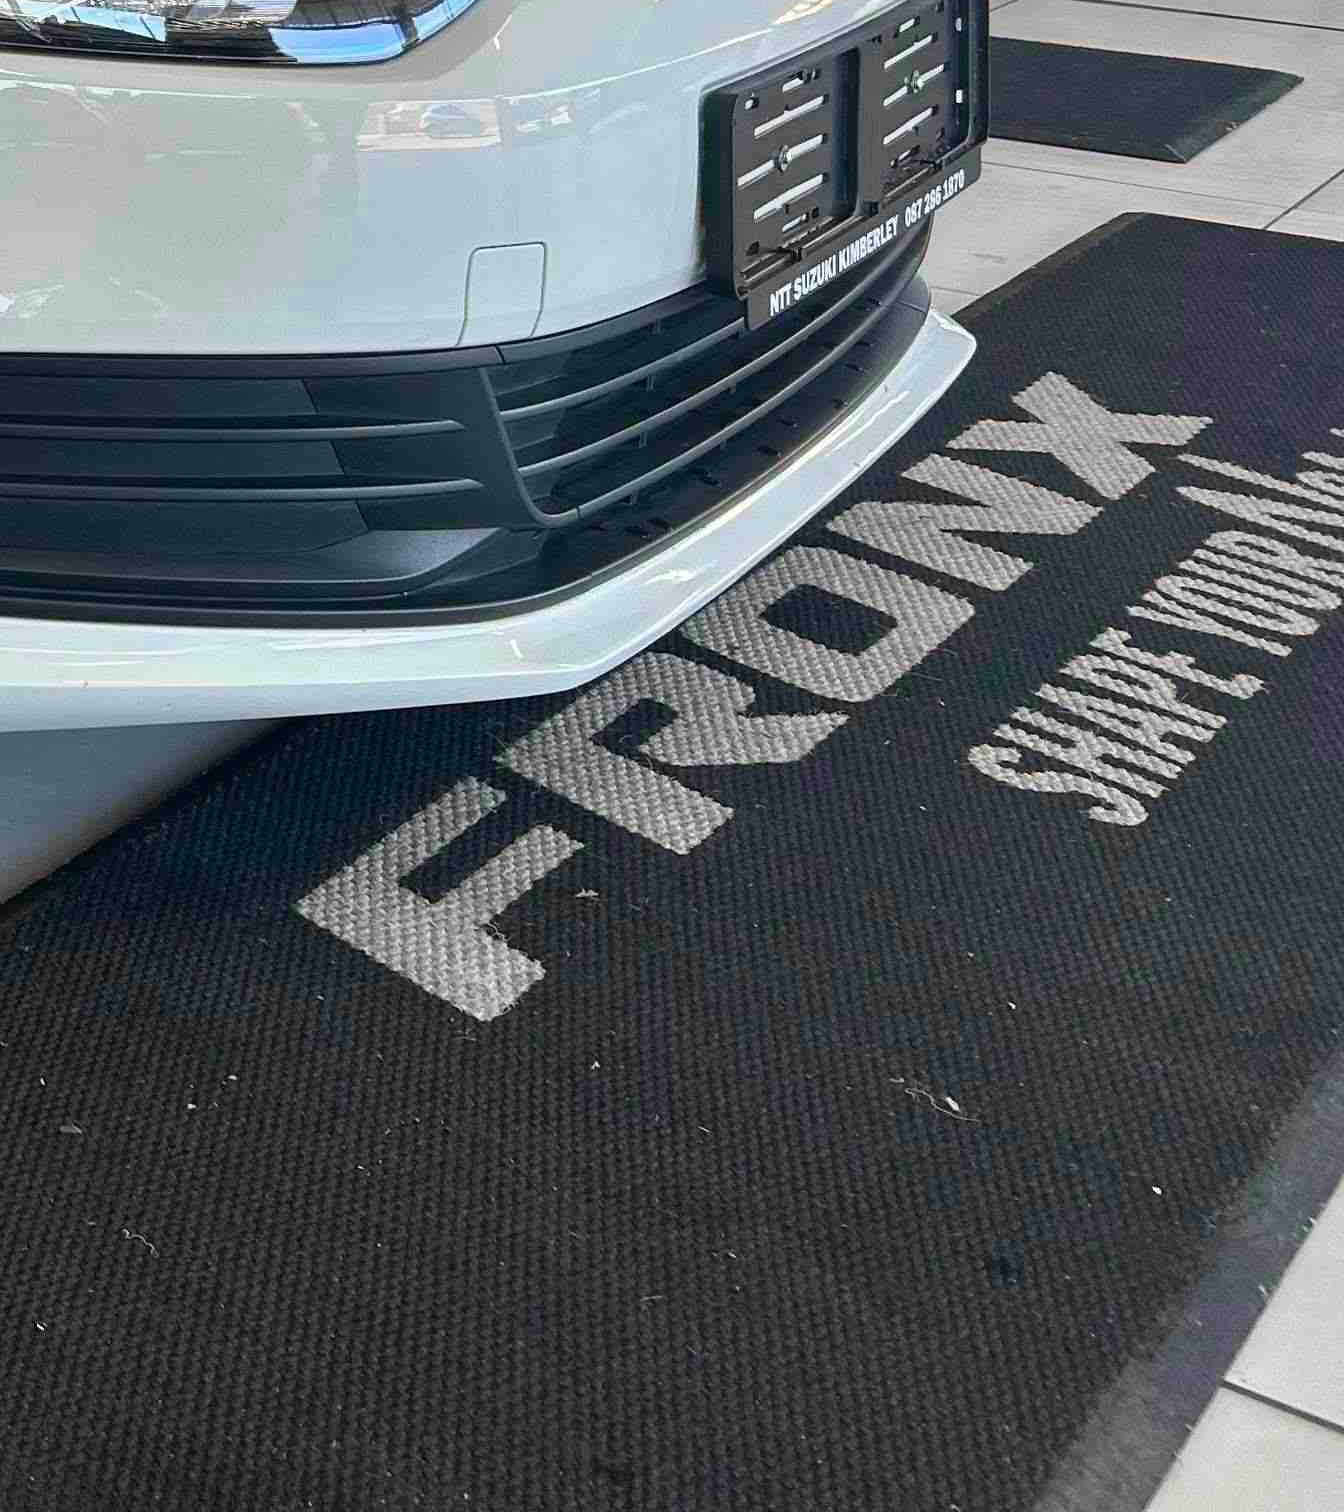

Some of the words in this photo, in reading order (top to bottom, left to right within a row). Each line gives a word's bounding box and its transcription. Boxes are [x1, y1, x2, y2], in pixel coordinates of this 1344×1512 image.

[769, 280, 793, 317] NTT
[794, 254, 837, 301] SUZUKI
[838, 214, 899, 273] KIMBERLEY
[904, 198, 924, 228] 087
[924, 184, 942, 215] 286
[942, 168, 965, 200] 1870
[296, 372, 1213, 1022] FRONX
[968, 626, 1266, 827] SHAPE
[1126, 530, 1344, 657] YOUR
